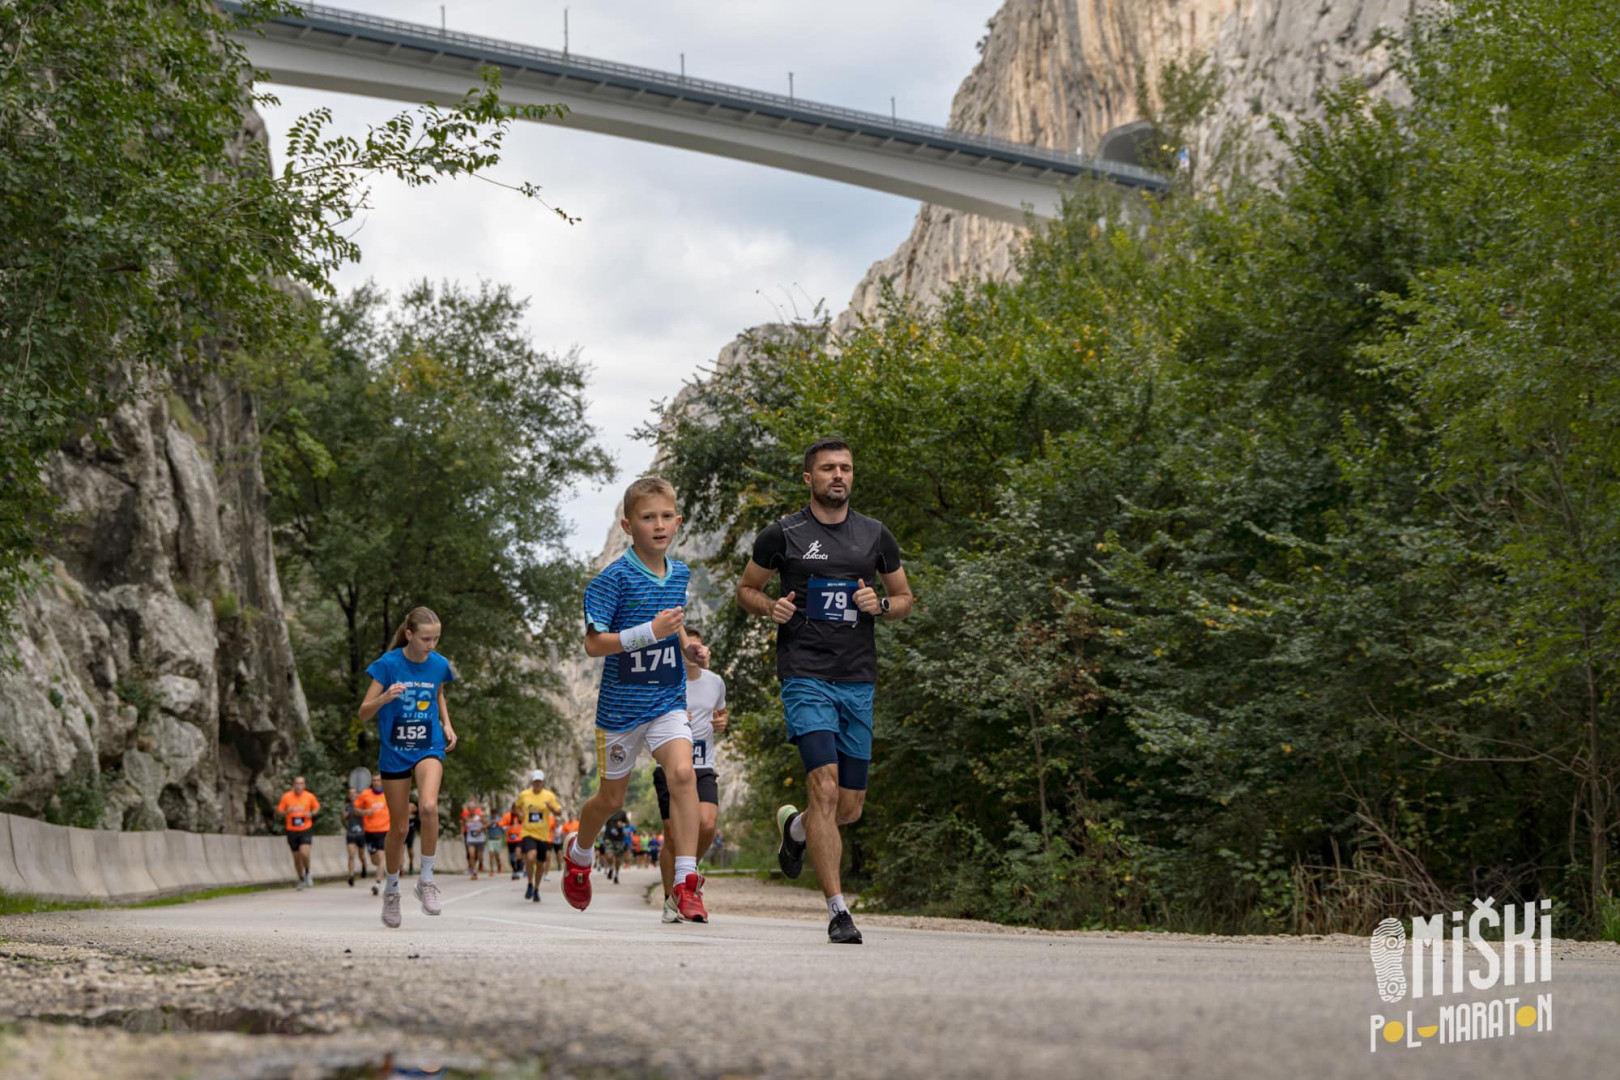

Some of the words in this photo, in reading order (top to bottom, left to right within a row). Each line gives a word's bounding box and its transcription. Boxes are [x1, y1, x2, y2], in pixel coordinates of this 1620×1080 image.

[821, 591, 848, 610] 79
[630, 646, 677, 672] 174
[396, 725, 427, 740] 152
